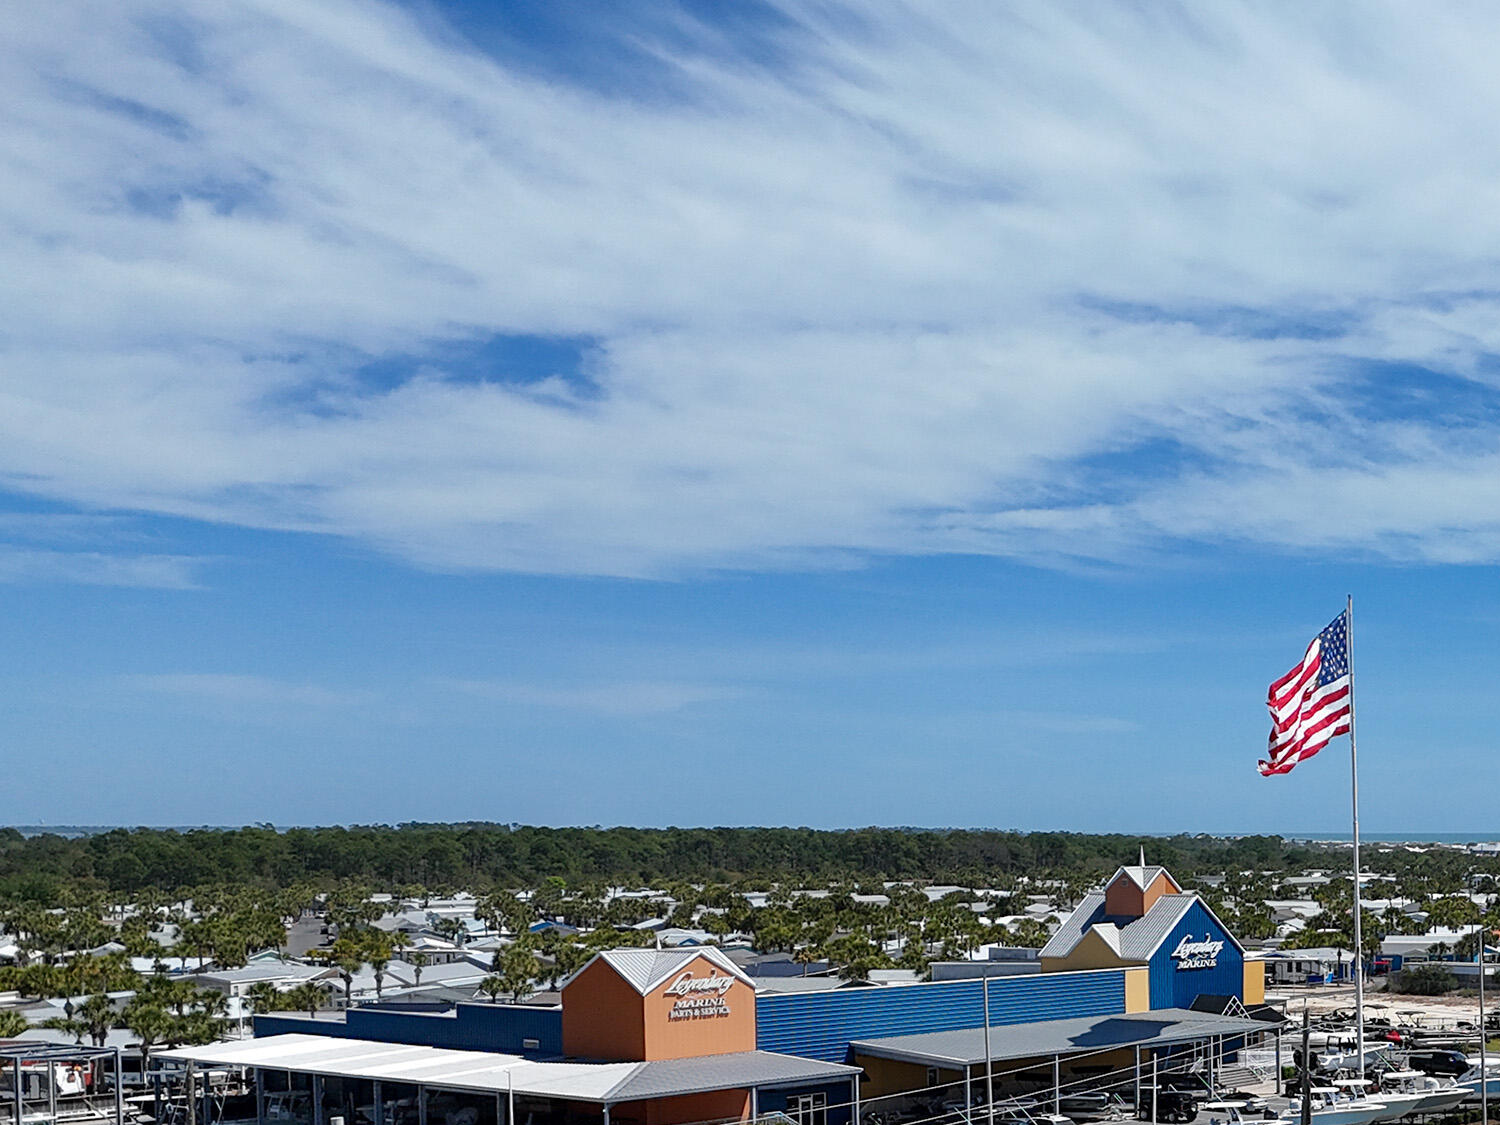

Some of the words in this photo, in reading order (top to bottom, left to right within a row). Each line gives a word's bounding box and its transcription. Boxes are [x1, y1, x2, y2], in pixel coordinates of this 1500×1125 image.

[1171, 932, 1224, 958] Legendary
[1177, 959, 1217, 969] MARINE
[664, 968, 735, 996] Legendary
[675, 998, 726, 1008] MARINE
[670, 1009, 693, 1018] PARTS
[701, 1006, 731, 1015] SERVICE
